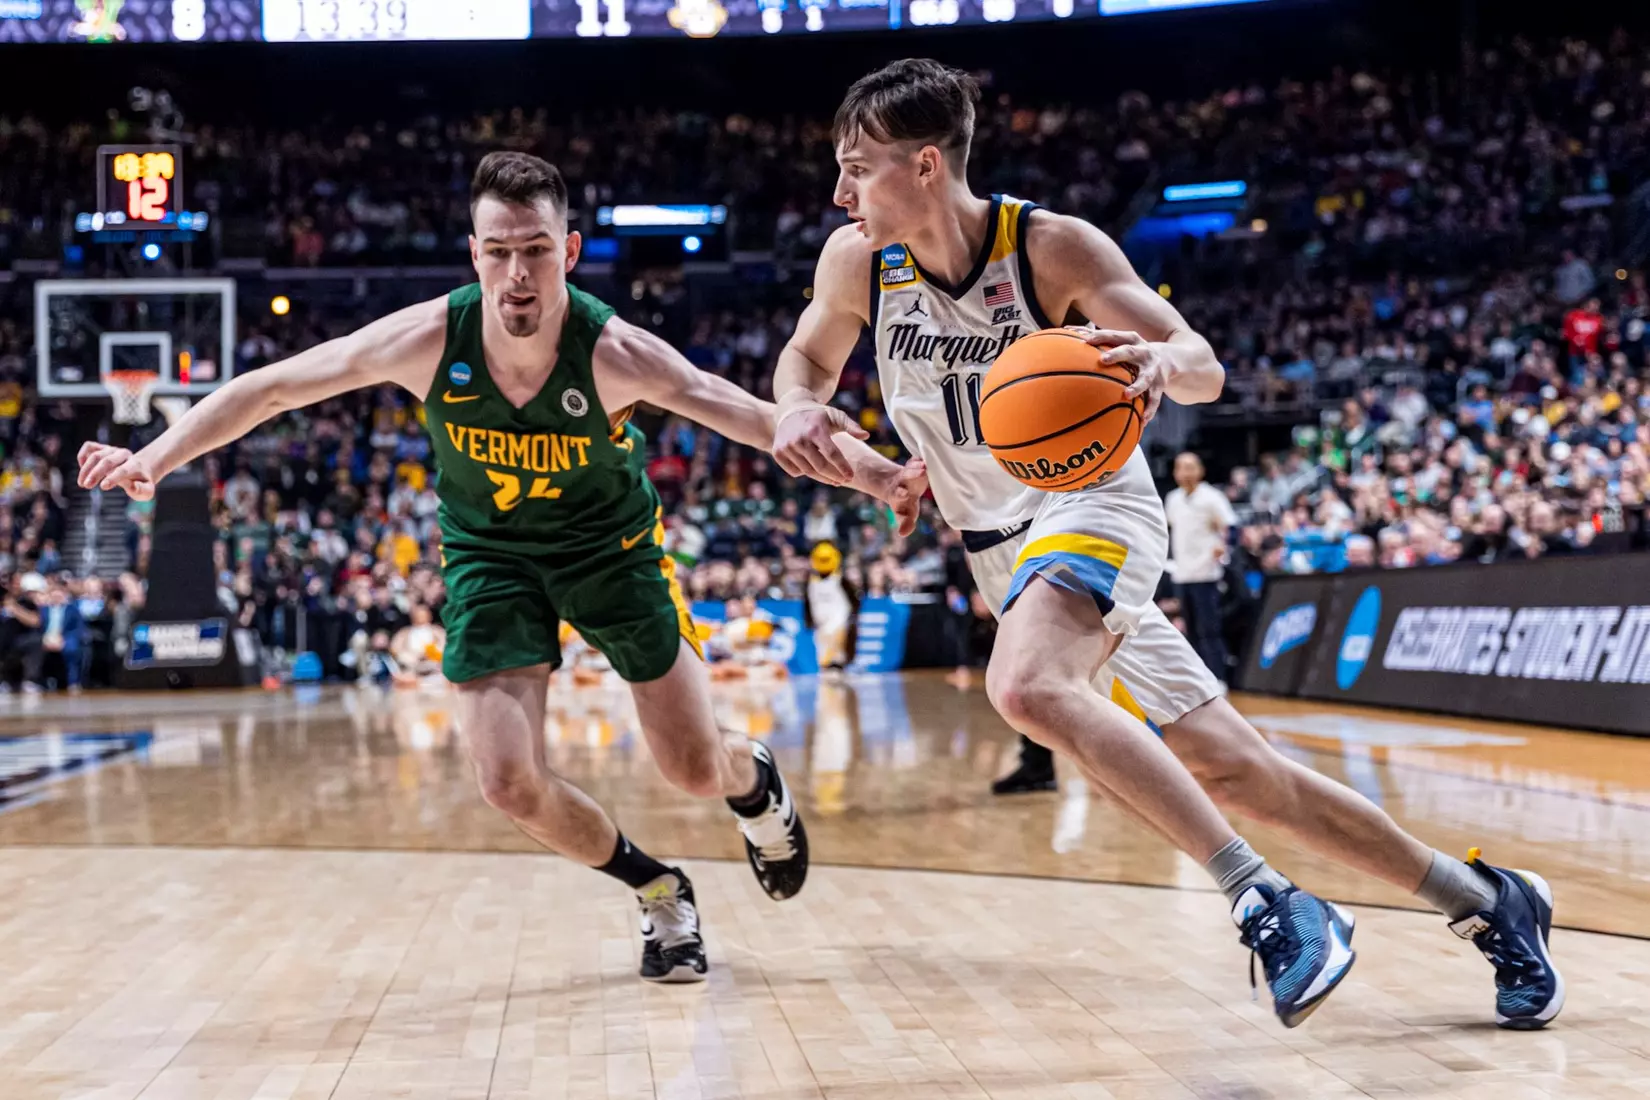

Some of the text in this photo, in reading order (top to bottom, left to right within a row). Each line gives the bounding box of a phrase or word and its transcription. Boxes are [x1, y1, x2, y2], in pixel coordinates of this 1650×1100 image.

[575, 0, 632, 37] 11
[128, 176, 169, 221] 12
[992, 310, 1021, 322] EAST
[994, 305, 1015, 314] BIG
[886, 324, 1028, 369] Marquett
[940, 373, 987, 446] 11
[444, 421, 592, 473] VERMONT
[998, 440, 1107, 481] Wilson
